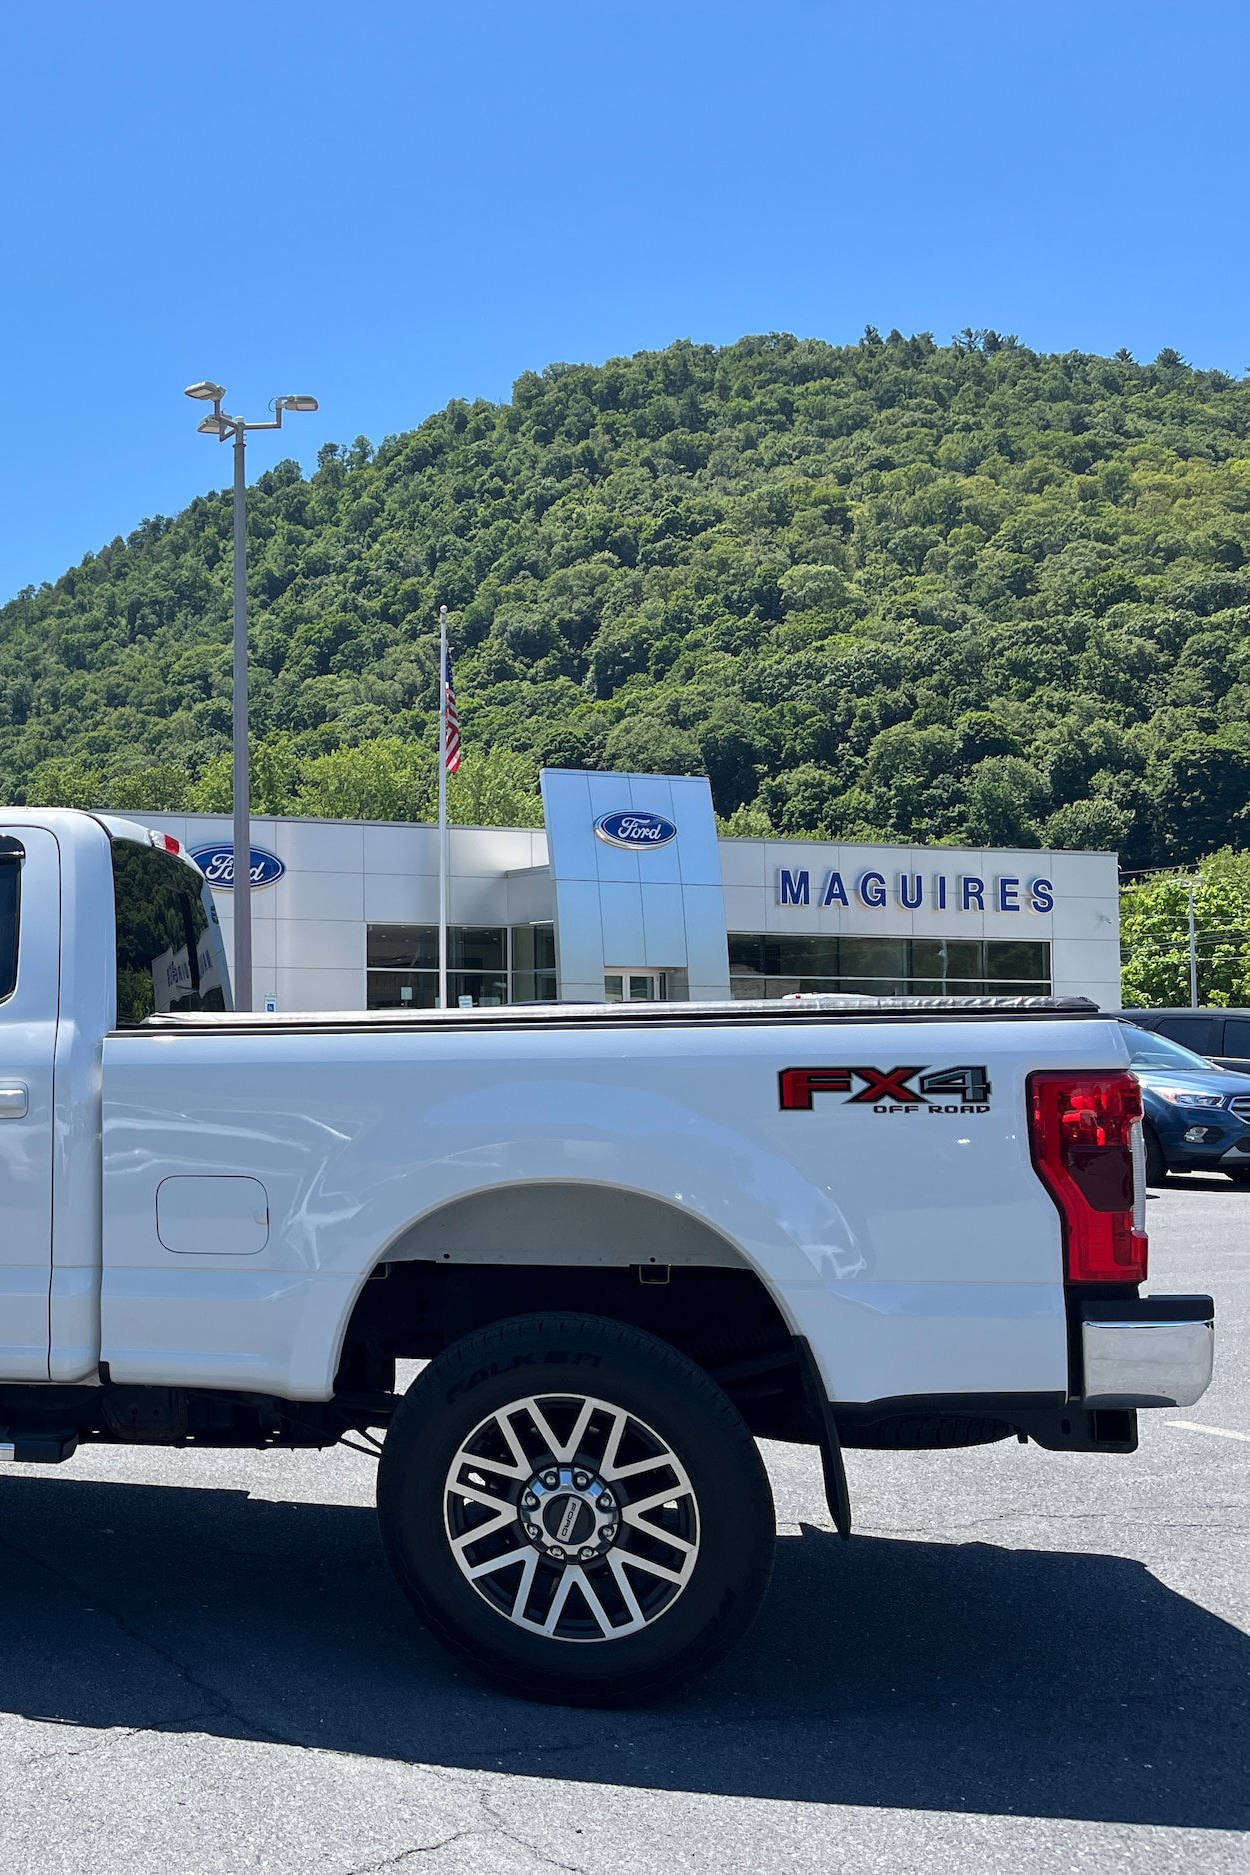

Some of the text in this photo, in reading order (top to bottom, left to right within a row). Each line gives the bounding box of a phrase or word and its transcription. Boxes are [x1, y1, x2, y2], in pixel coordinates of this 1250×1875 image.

[617, 817, 662, 840] Ford
[205, 853, 266, 881] Fod
[778, 868, 1055, 914] MAGUIRES
[777, 1065, 993, 1111] FX4
[872, 1105, 991, 1114] OFF ROAD
[561, 1502, 577, 1537] FORD
